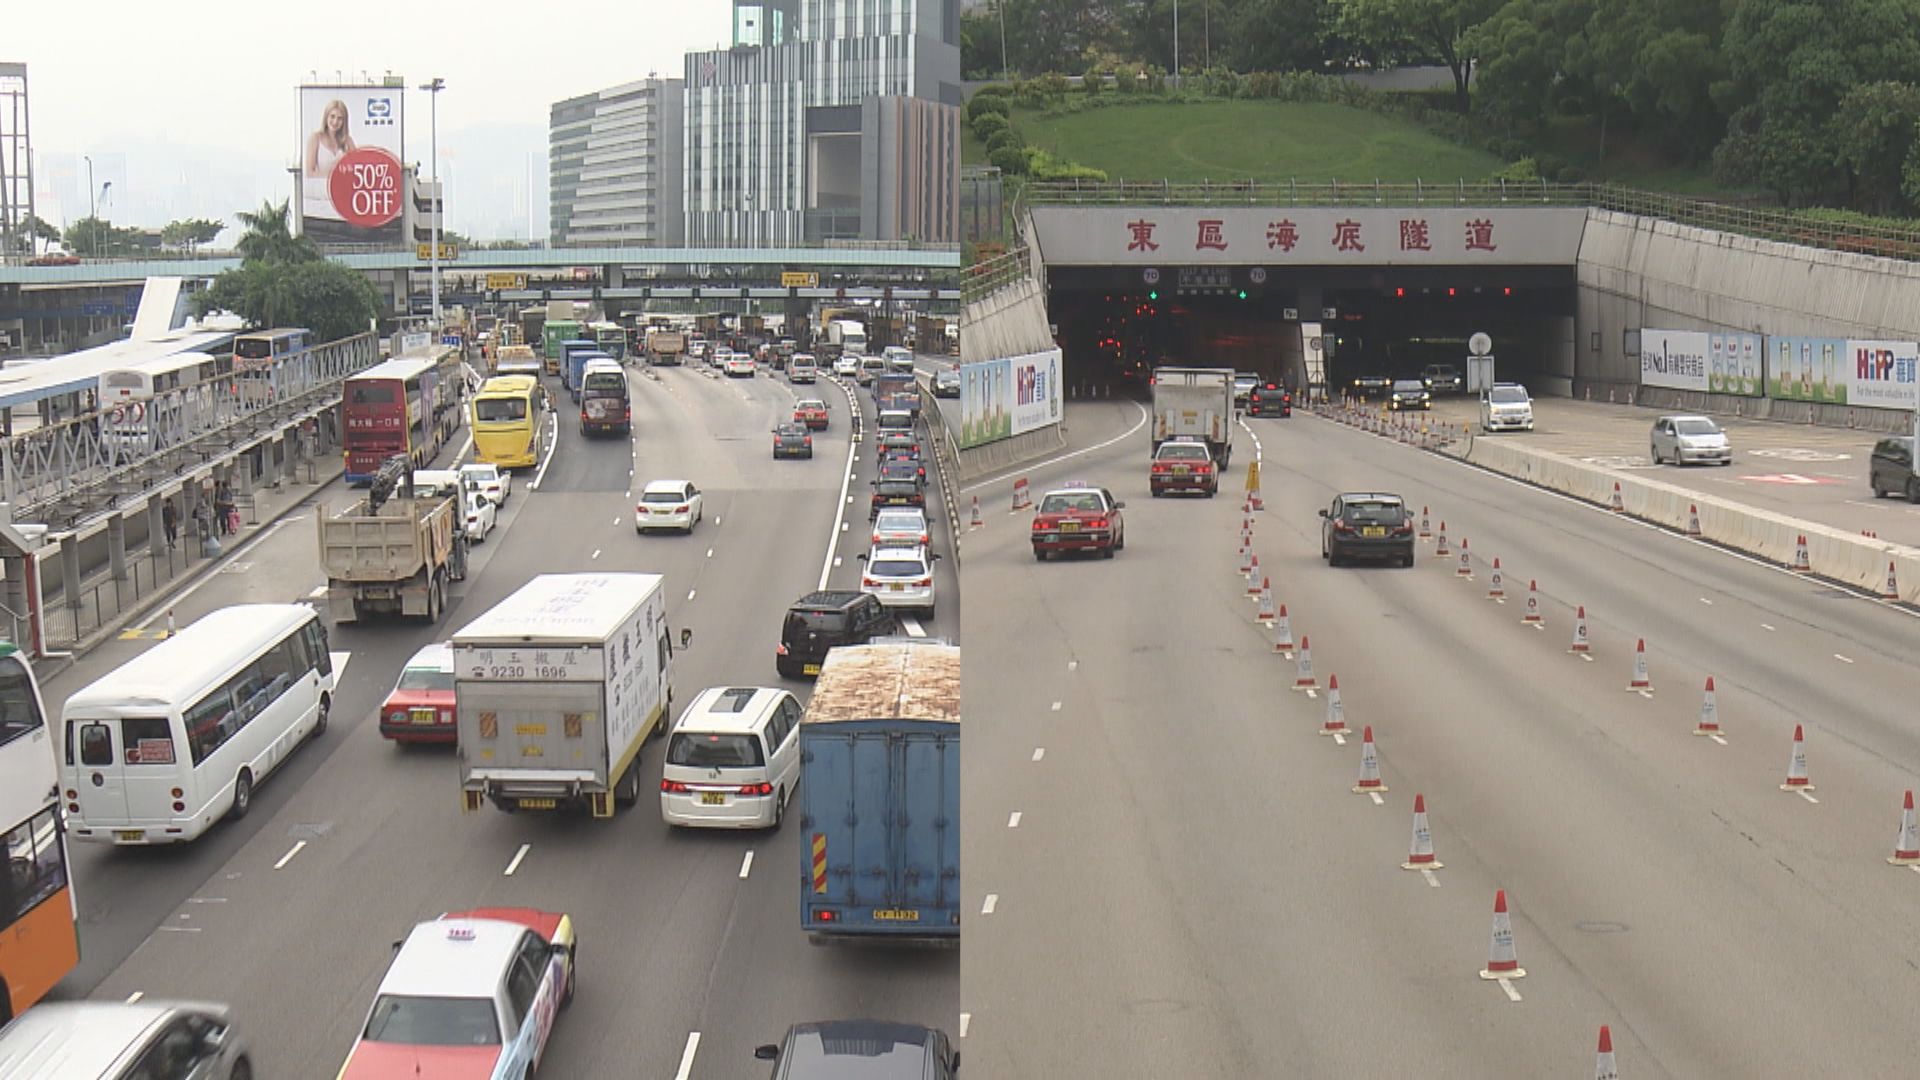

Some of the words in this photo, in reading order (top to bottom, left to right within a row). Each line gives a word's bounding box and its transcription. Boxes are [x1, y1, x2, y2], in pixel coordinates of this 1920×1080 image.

[352, 163, 393, 190] 50%
[1127, 218, 1497, 252] 東區海底隧道
[1857, 347, 1894, 381] HiPP
[491, 665, 524, 678] 9230
[535, 665, 567, 678] 1696
